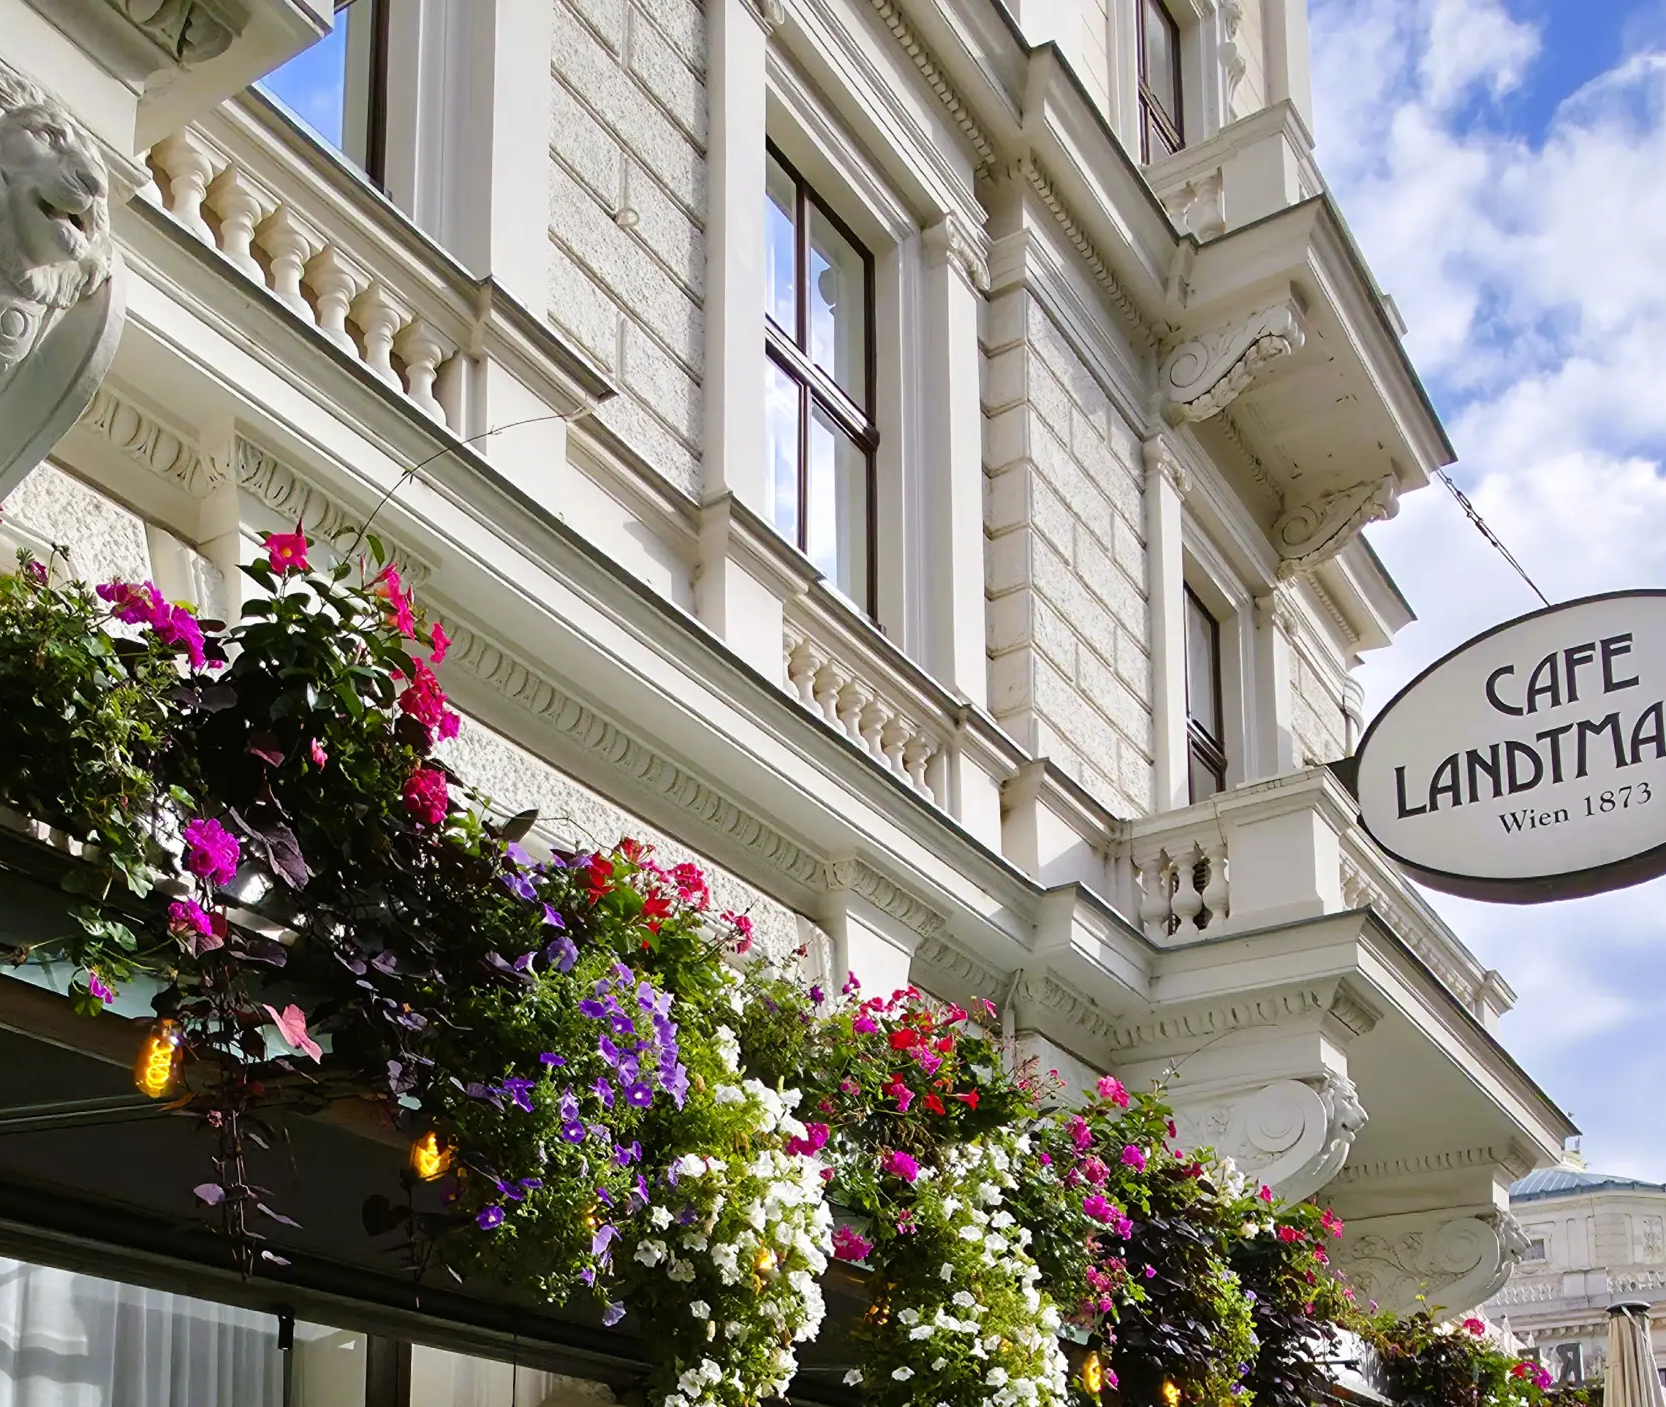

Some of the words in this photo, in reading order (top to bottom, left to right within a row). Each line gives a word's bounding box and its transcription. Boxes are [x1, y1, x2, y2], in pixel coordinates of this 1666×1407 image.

[1485, 632, 1640, 717] CAFE
[1498, 807, 1570, 835] Wien
[1583, 781, 1654, 817] 1873
